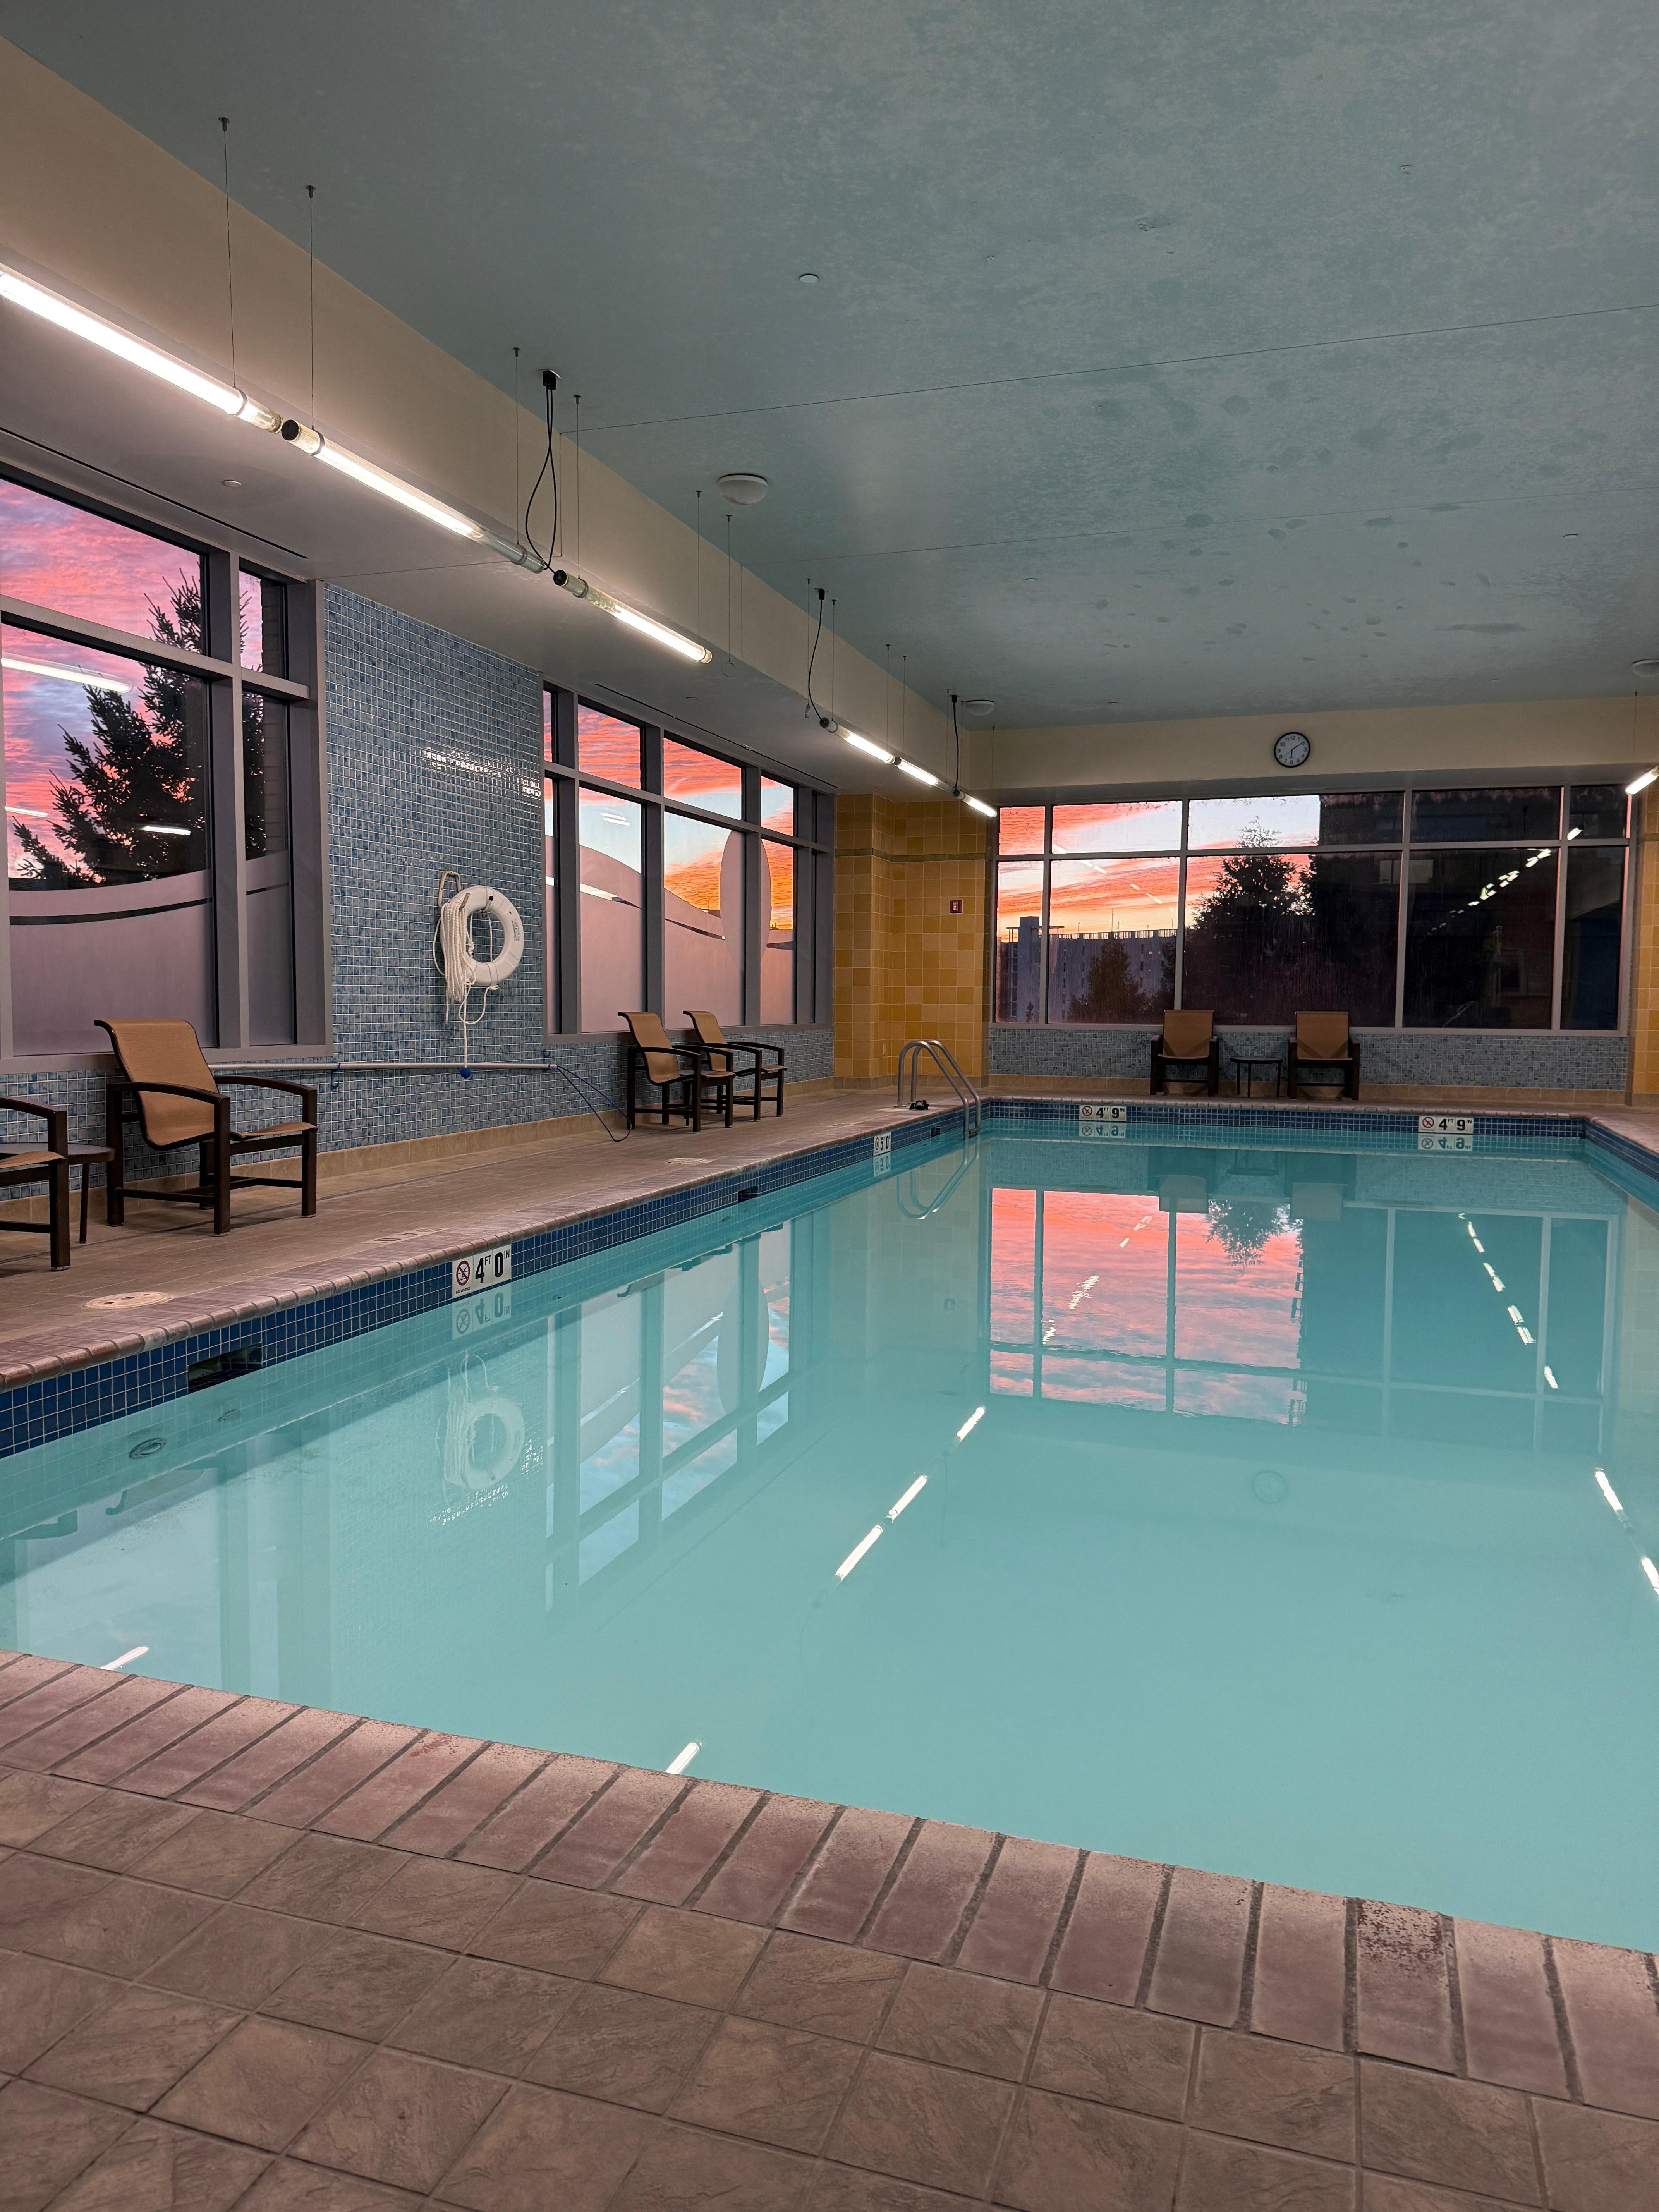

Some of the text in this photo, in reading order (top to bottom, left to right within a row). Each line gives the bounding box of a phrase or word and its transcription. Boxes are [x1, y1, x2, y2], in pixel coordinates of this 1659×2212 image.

[1096, 1107, 1104, 1118] 4
[1112, 1108, 1119, 1118] 9
[1439, 1119, 1448, 1130] 4
[1457, 1120, 1465, 1131] 9
[881, 1135, 889, 1151] 5 0
[475, 1249, 510, 1283] 4 FT 0 IN
